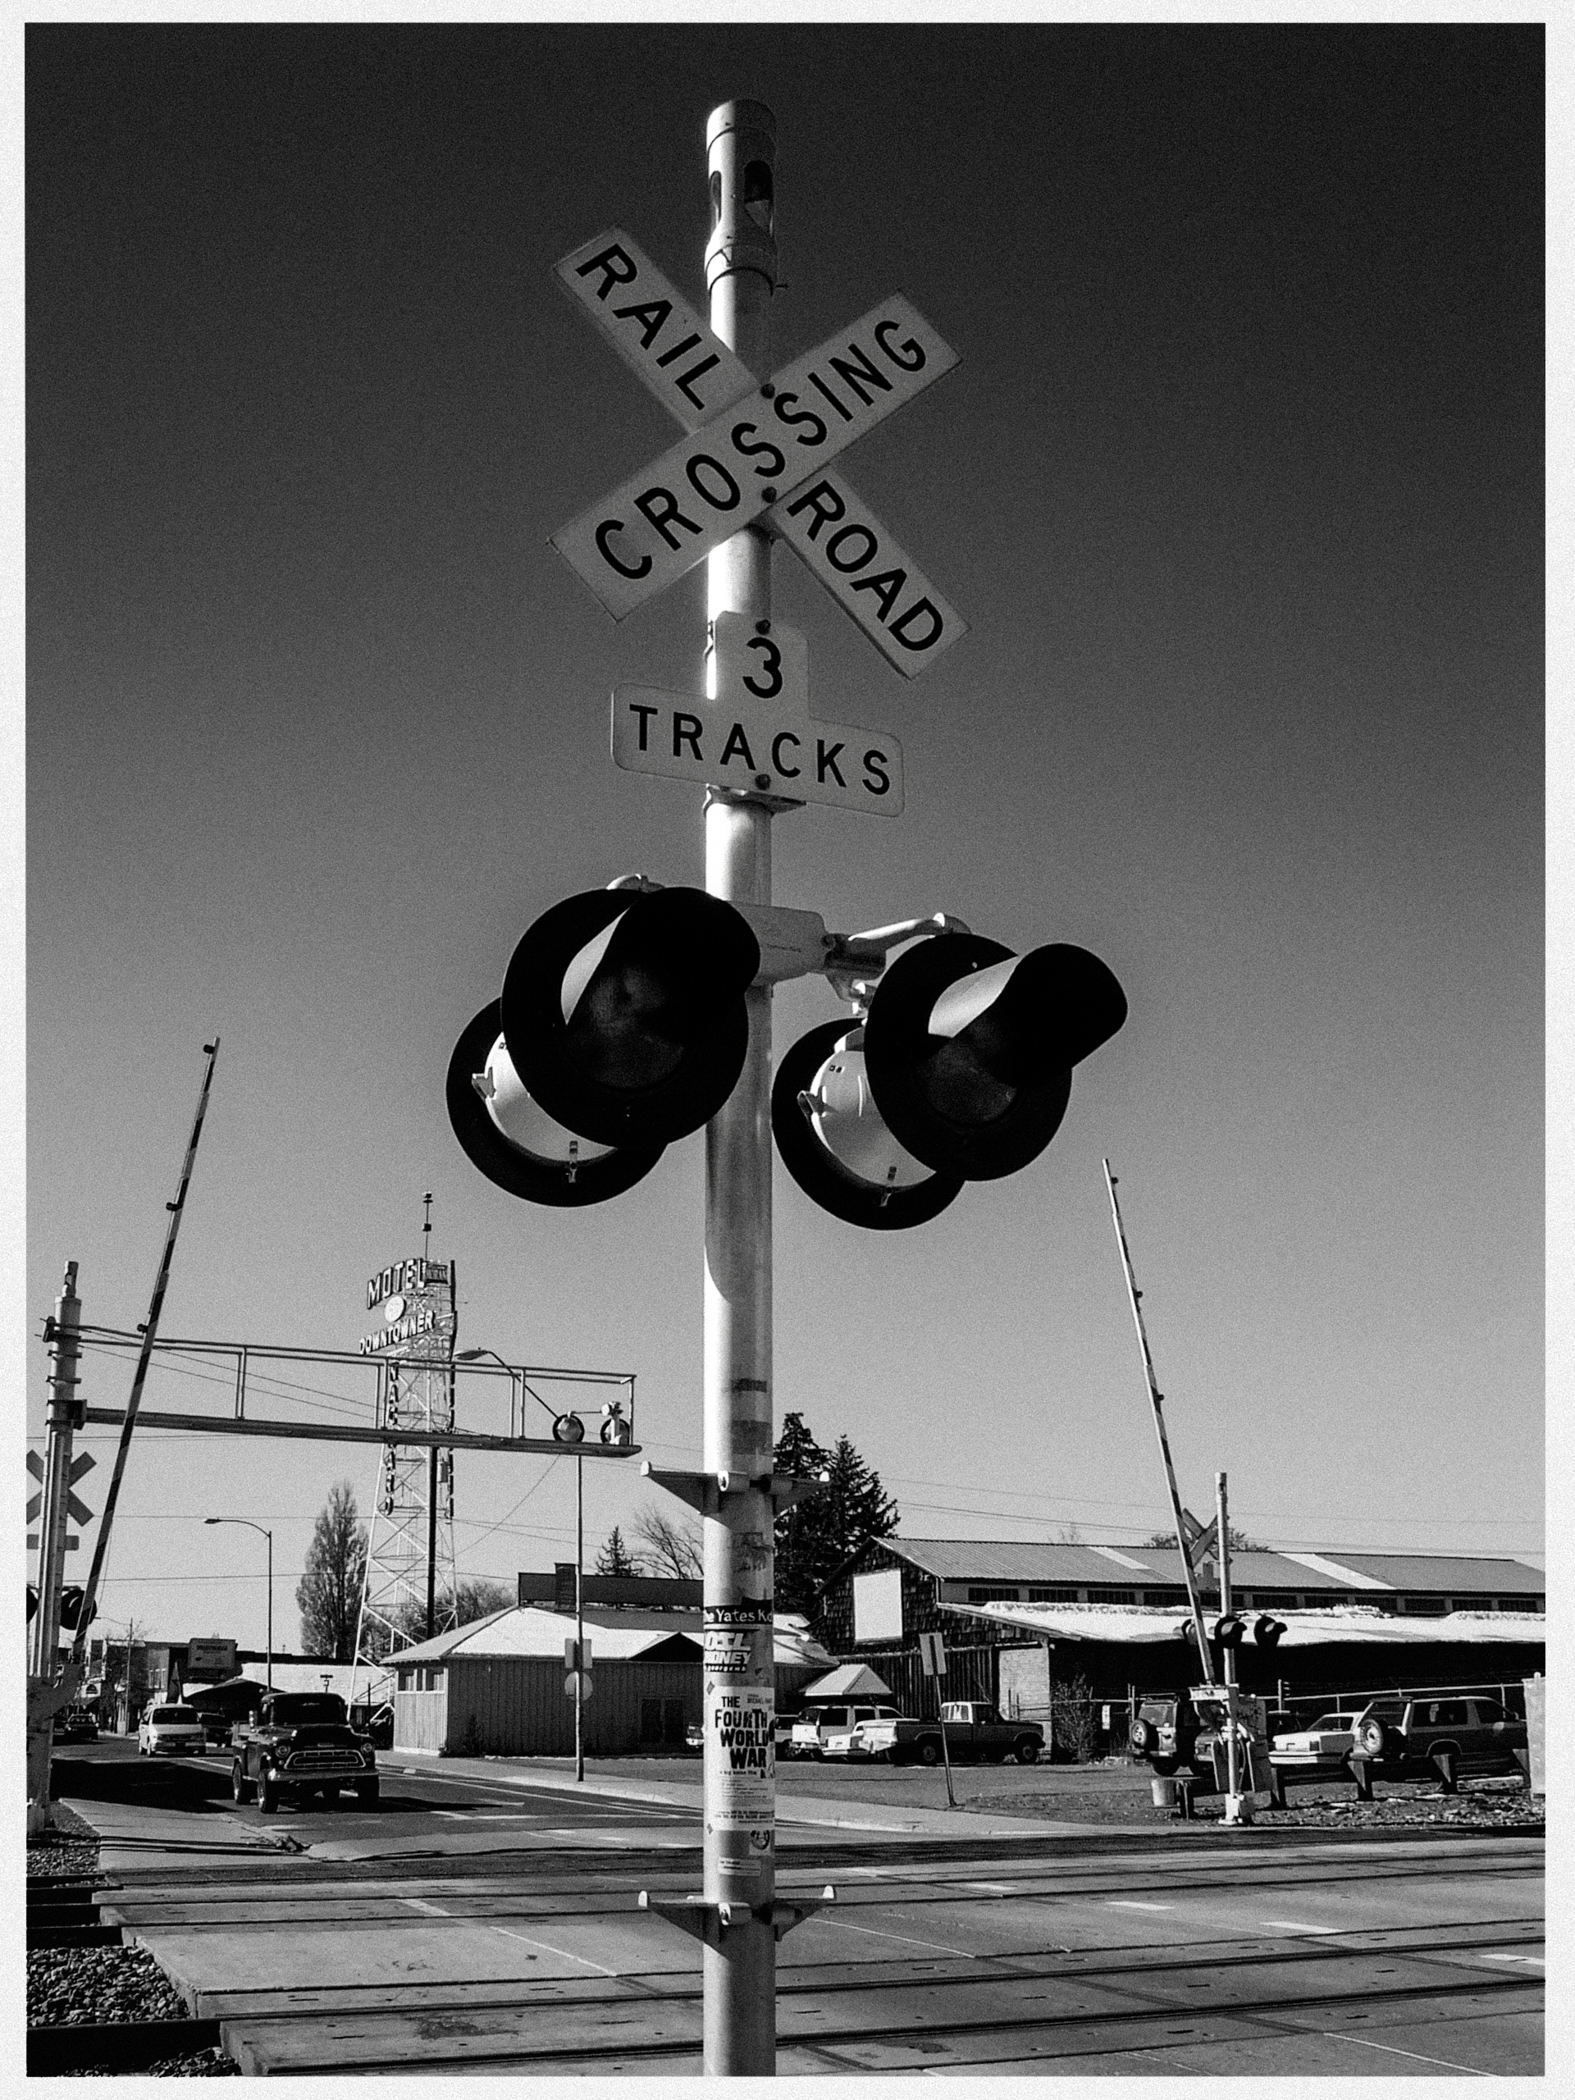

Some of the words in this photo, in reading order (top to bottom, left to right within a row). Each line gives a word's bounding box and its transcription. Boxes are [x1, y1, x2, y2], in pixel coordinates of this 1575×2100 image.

[575, 243, 721, 410] RAIL
[786, 480, 944, 652] ROAD
[595, 320, 926, 580] CROSSING
[742, 637, 783, 699] 3
[629, 704, 890, 796] TRACKS
[367, 1258, 426, 1310] MOTEL
[359, 1309, 435, 1354] DOWNTOWNER
[716, 1608, 755, 1622] Yates
[715, 1708, 767, 1728] FOURTH
[721, 1696, 740, 1708] THE
[720, 1728, 769, 1747] WORLD
[730, 1747, 767, 1769] WAR
